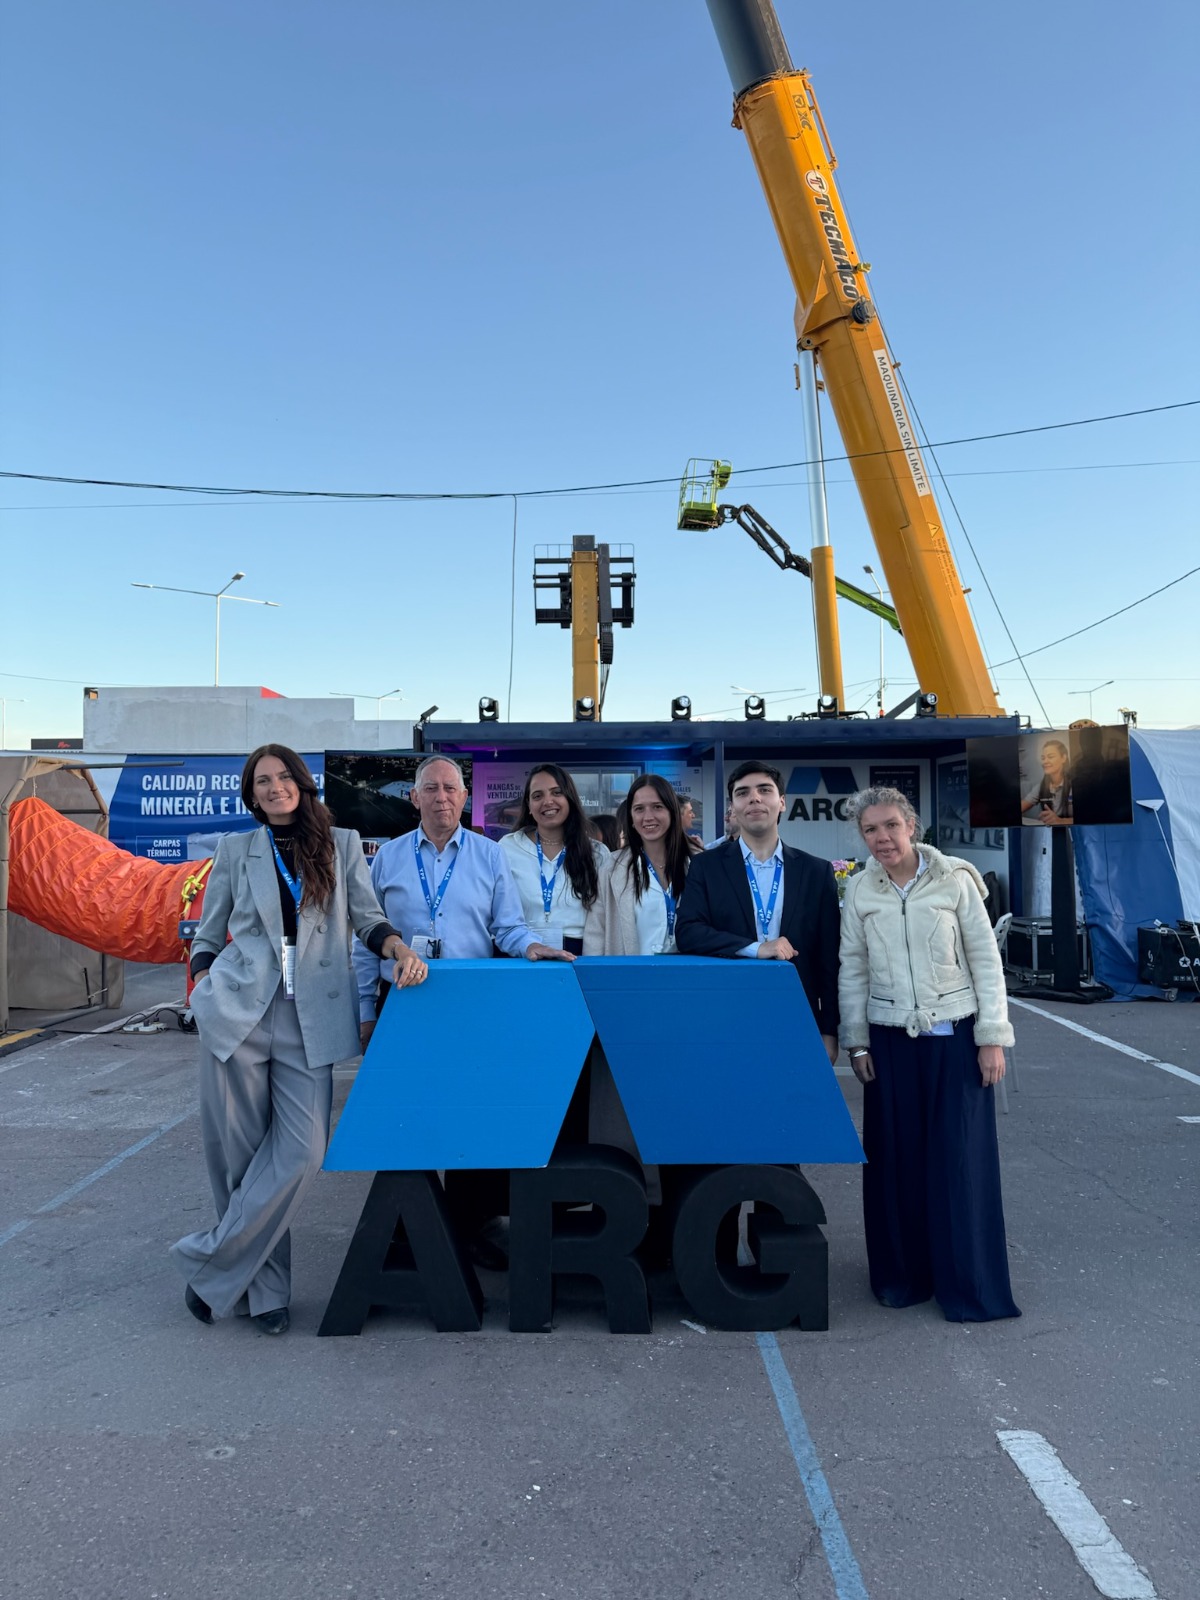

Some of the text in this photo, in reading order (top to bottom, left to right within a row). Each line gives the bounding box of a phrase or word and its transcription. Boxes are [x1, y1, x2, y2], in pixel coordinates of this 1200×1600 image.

[814, 193, 859, 301] TECMACO
[877, 356, 926, 492] MAQUINARIA SIN LÍMITE.
[142, 774, 207, 791] CALIDAD
[211, 774, 240, 791] REC
[487, 783, 514, 791] MANGAS
[141, 791, 214, 816] MINERÍA
[220, 796, 230, 815] E
[147, 848, 181, 858] TÉRMICAS
[153, 839, 181, 848] CARPAS
[317, 1164, 828, 1336] ARG
